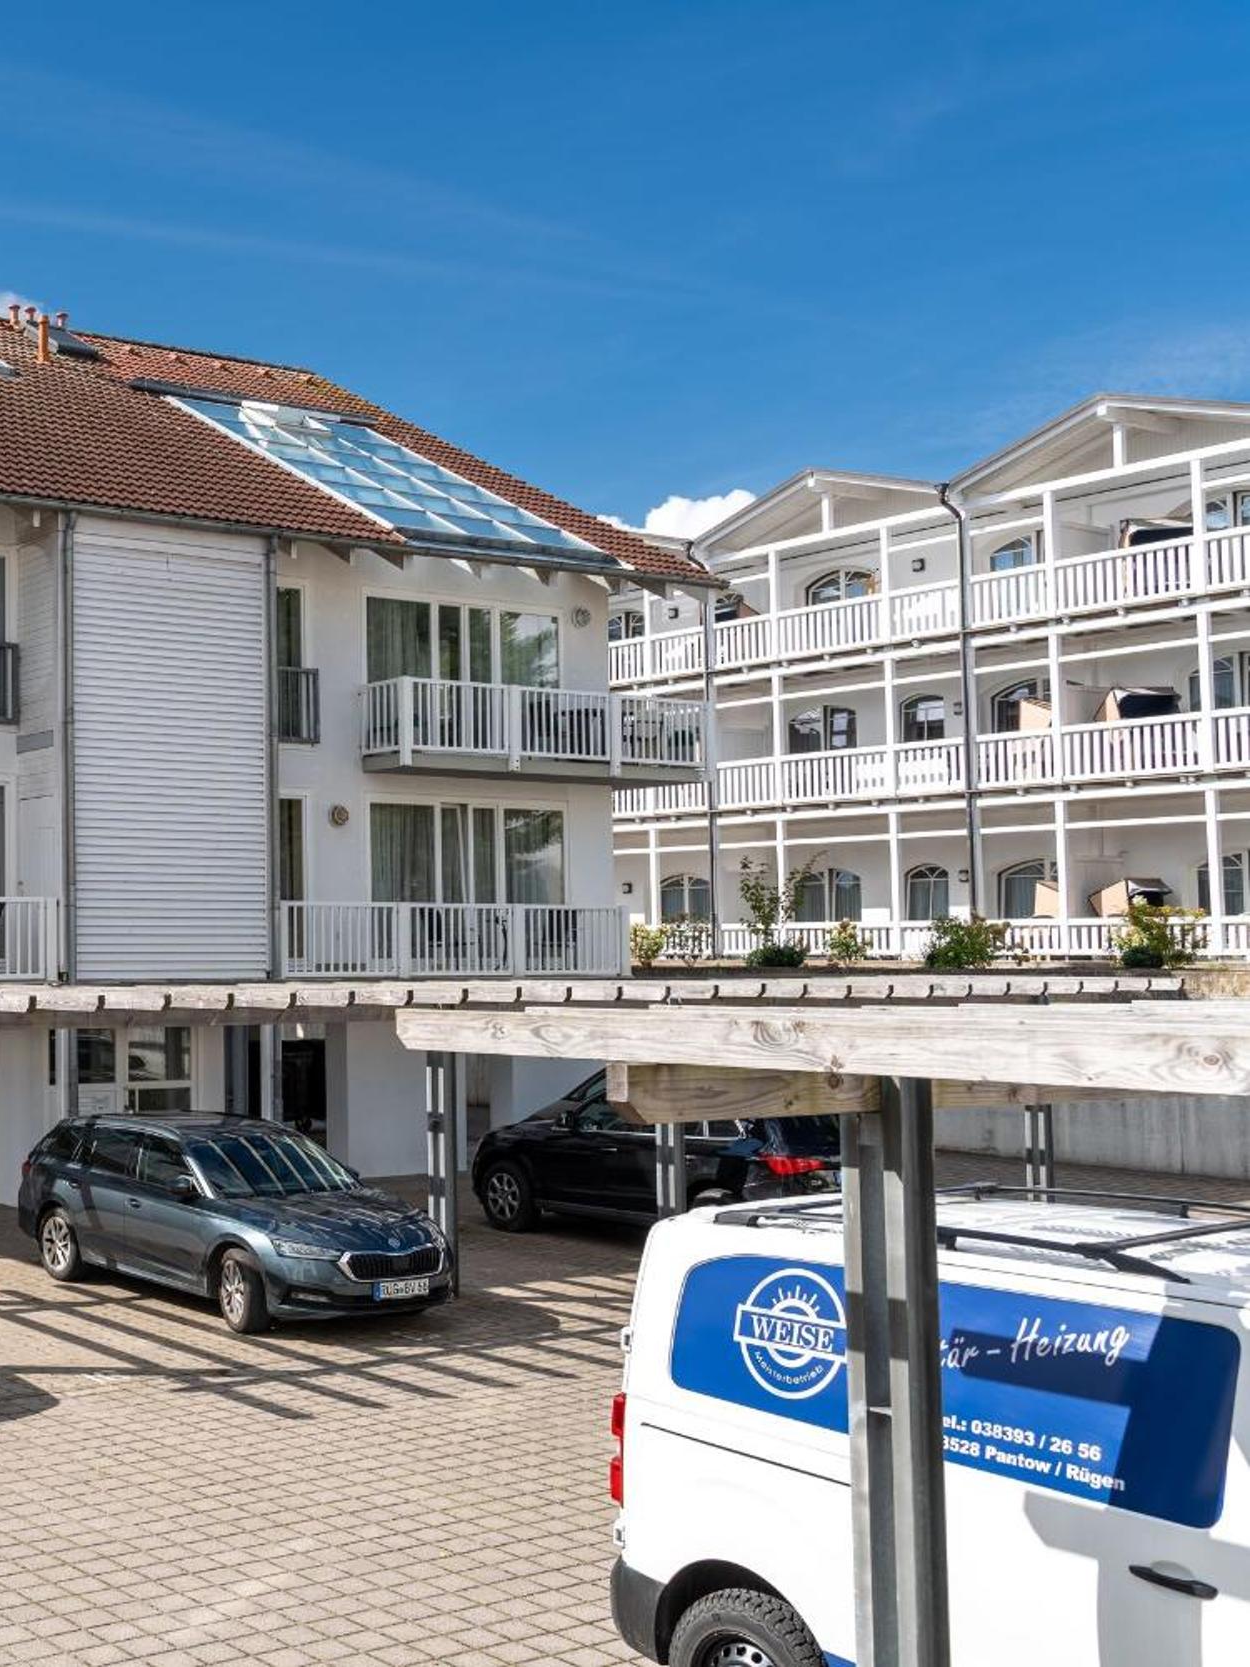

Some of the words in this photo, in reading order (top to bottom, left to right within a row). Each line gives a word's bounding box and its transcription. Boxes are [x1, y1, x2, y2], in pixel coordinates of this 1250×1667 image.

[751, 1315, 834, 1352] WEISE
[1010, 1317, 1130, 1366] Heizung
[942, 1414, 967, 1431] el.:
[971, 1420, 1035, 1447] 038393
[1049, 1437, 1073, 1455] 26
[1077, 1443, 1102, 1462] 56
[985, 1445, 1052, 1474] Pantow
[1066, 1463, 1126, 1492] Rügen
